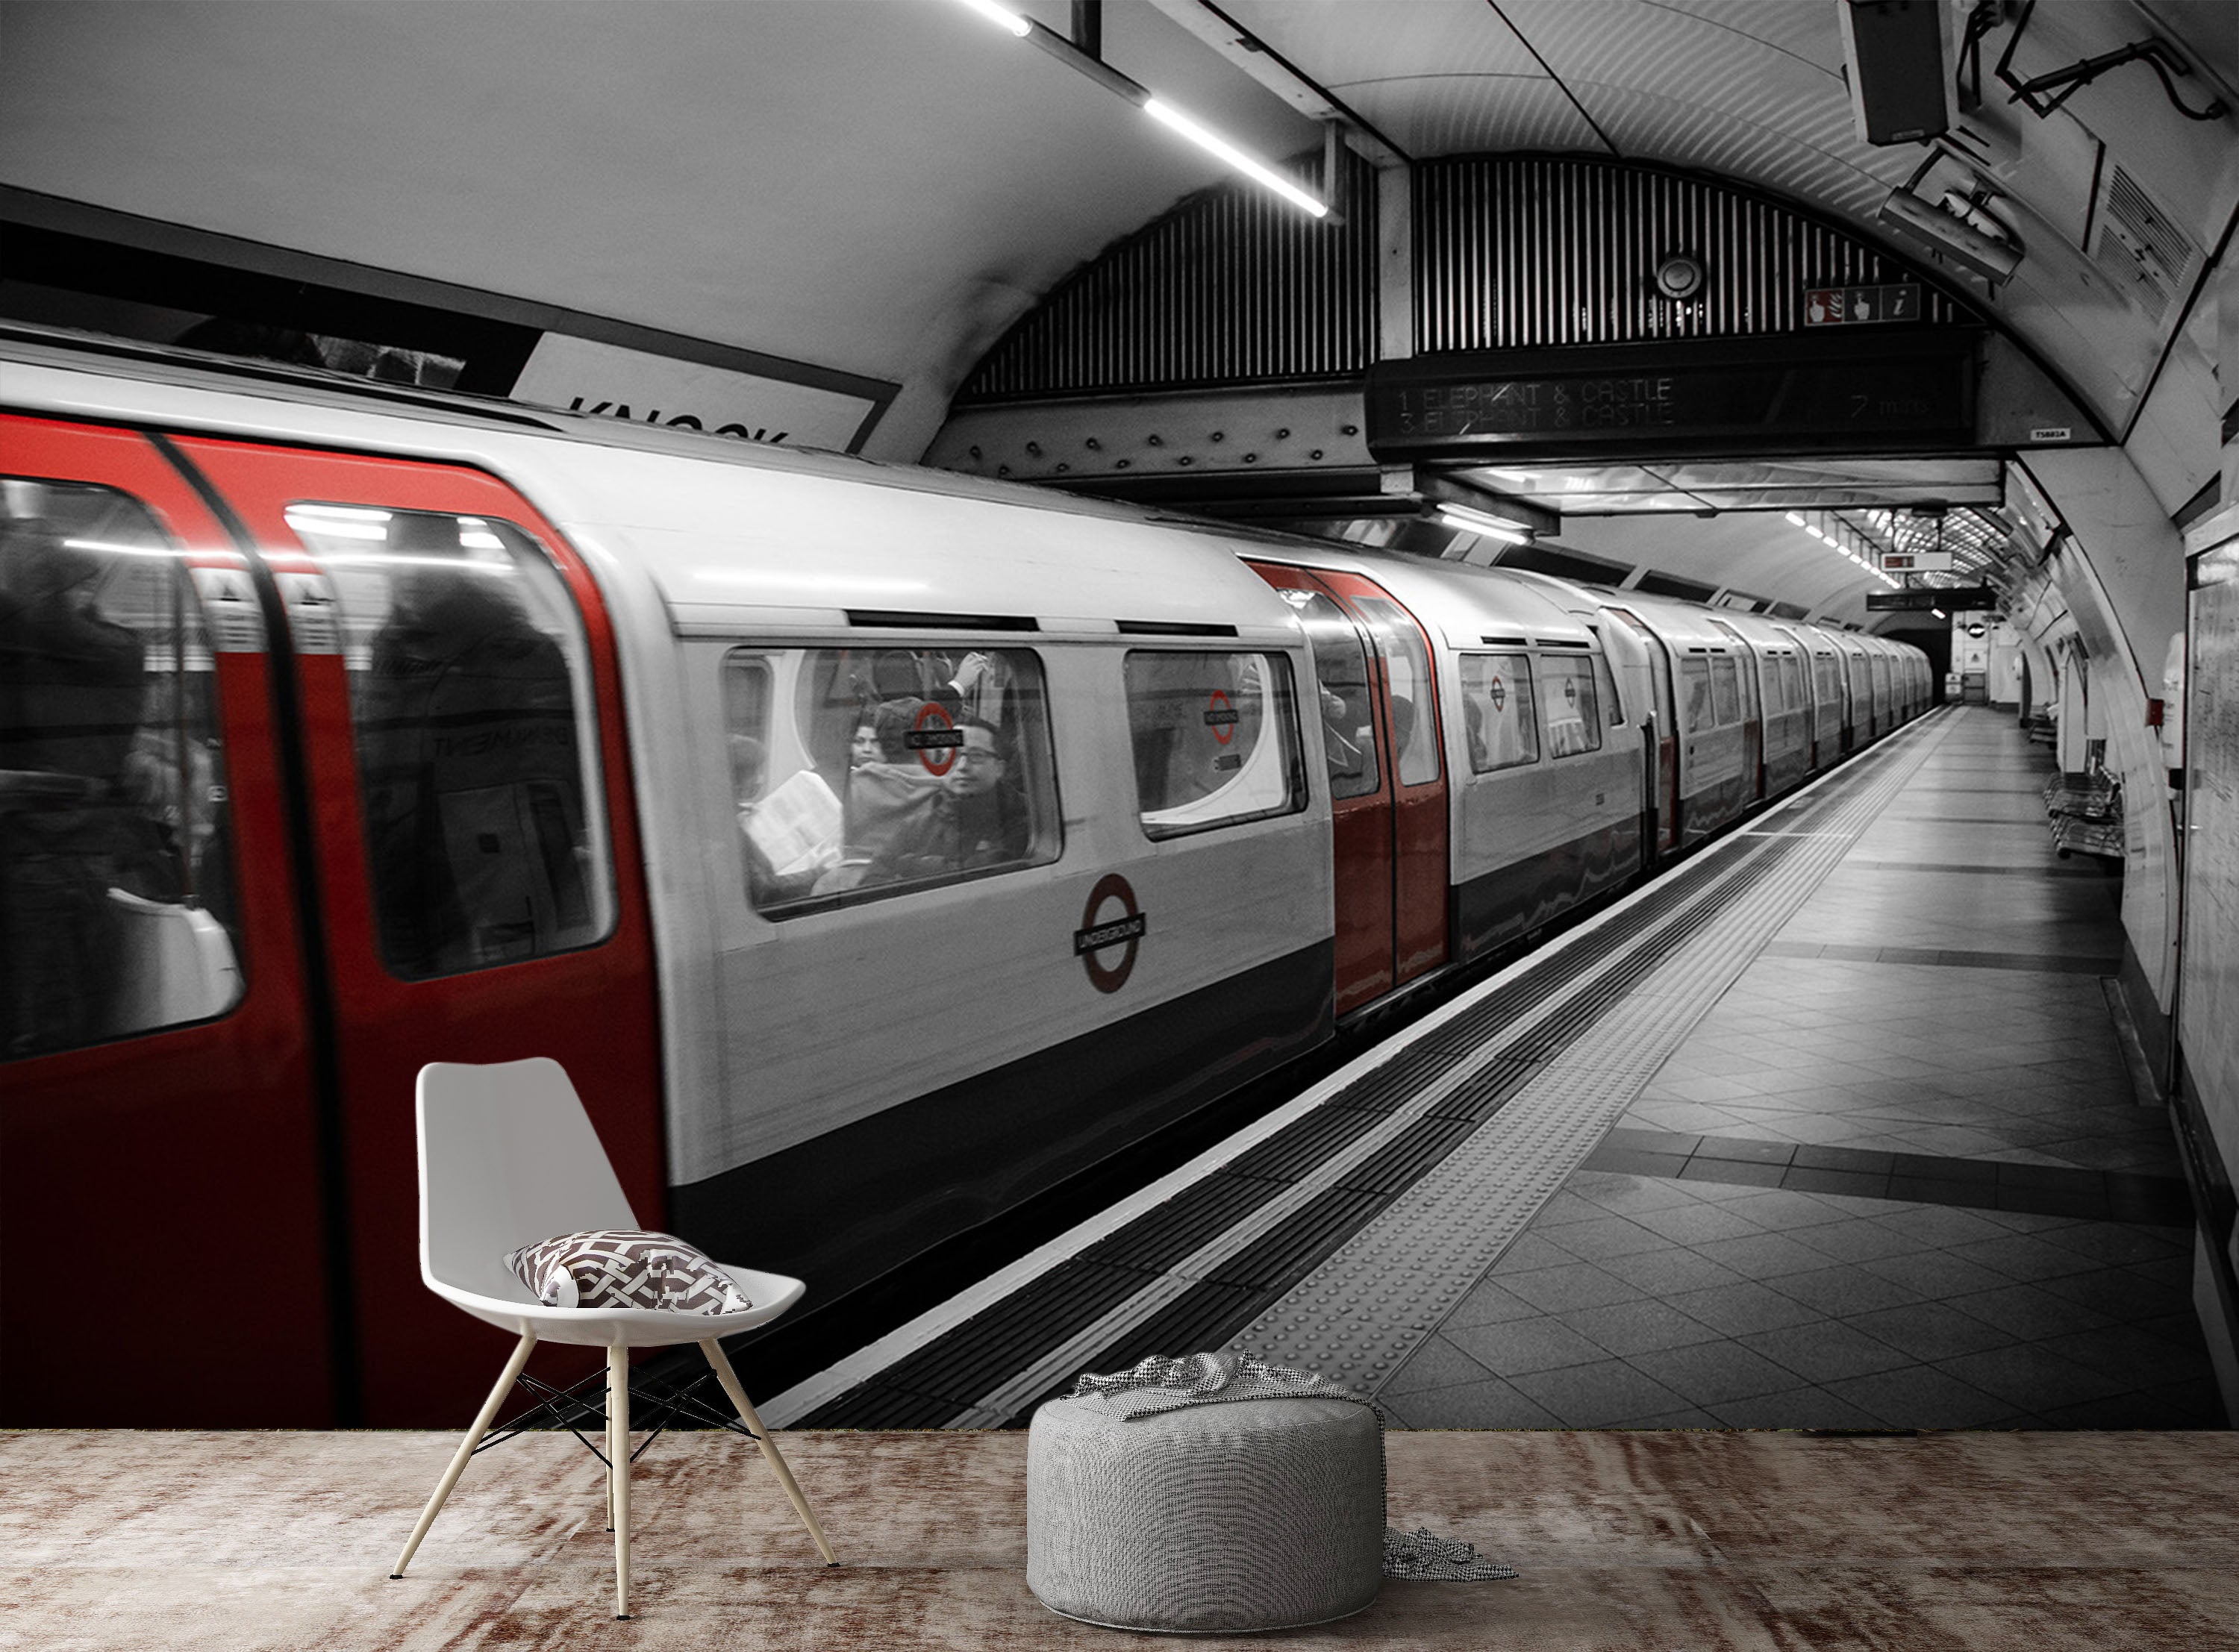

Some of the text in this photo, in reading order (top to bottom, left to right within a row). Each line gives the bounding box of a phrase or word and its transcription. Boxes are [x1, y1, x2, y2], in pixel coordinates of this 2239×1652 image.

[1399, 378, 1673, 411] 1 ELEPHANT & CASTLE
[1399, 412, 1414, 435] 3
[1554, 407, 1570, 428] &
[1582, 402, 1674, 426] CASTLE
[1078, 919, 1141, 948] UNDERGROUND
